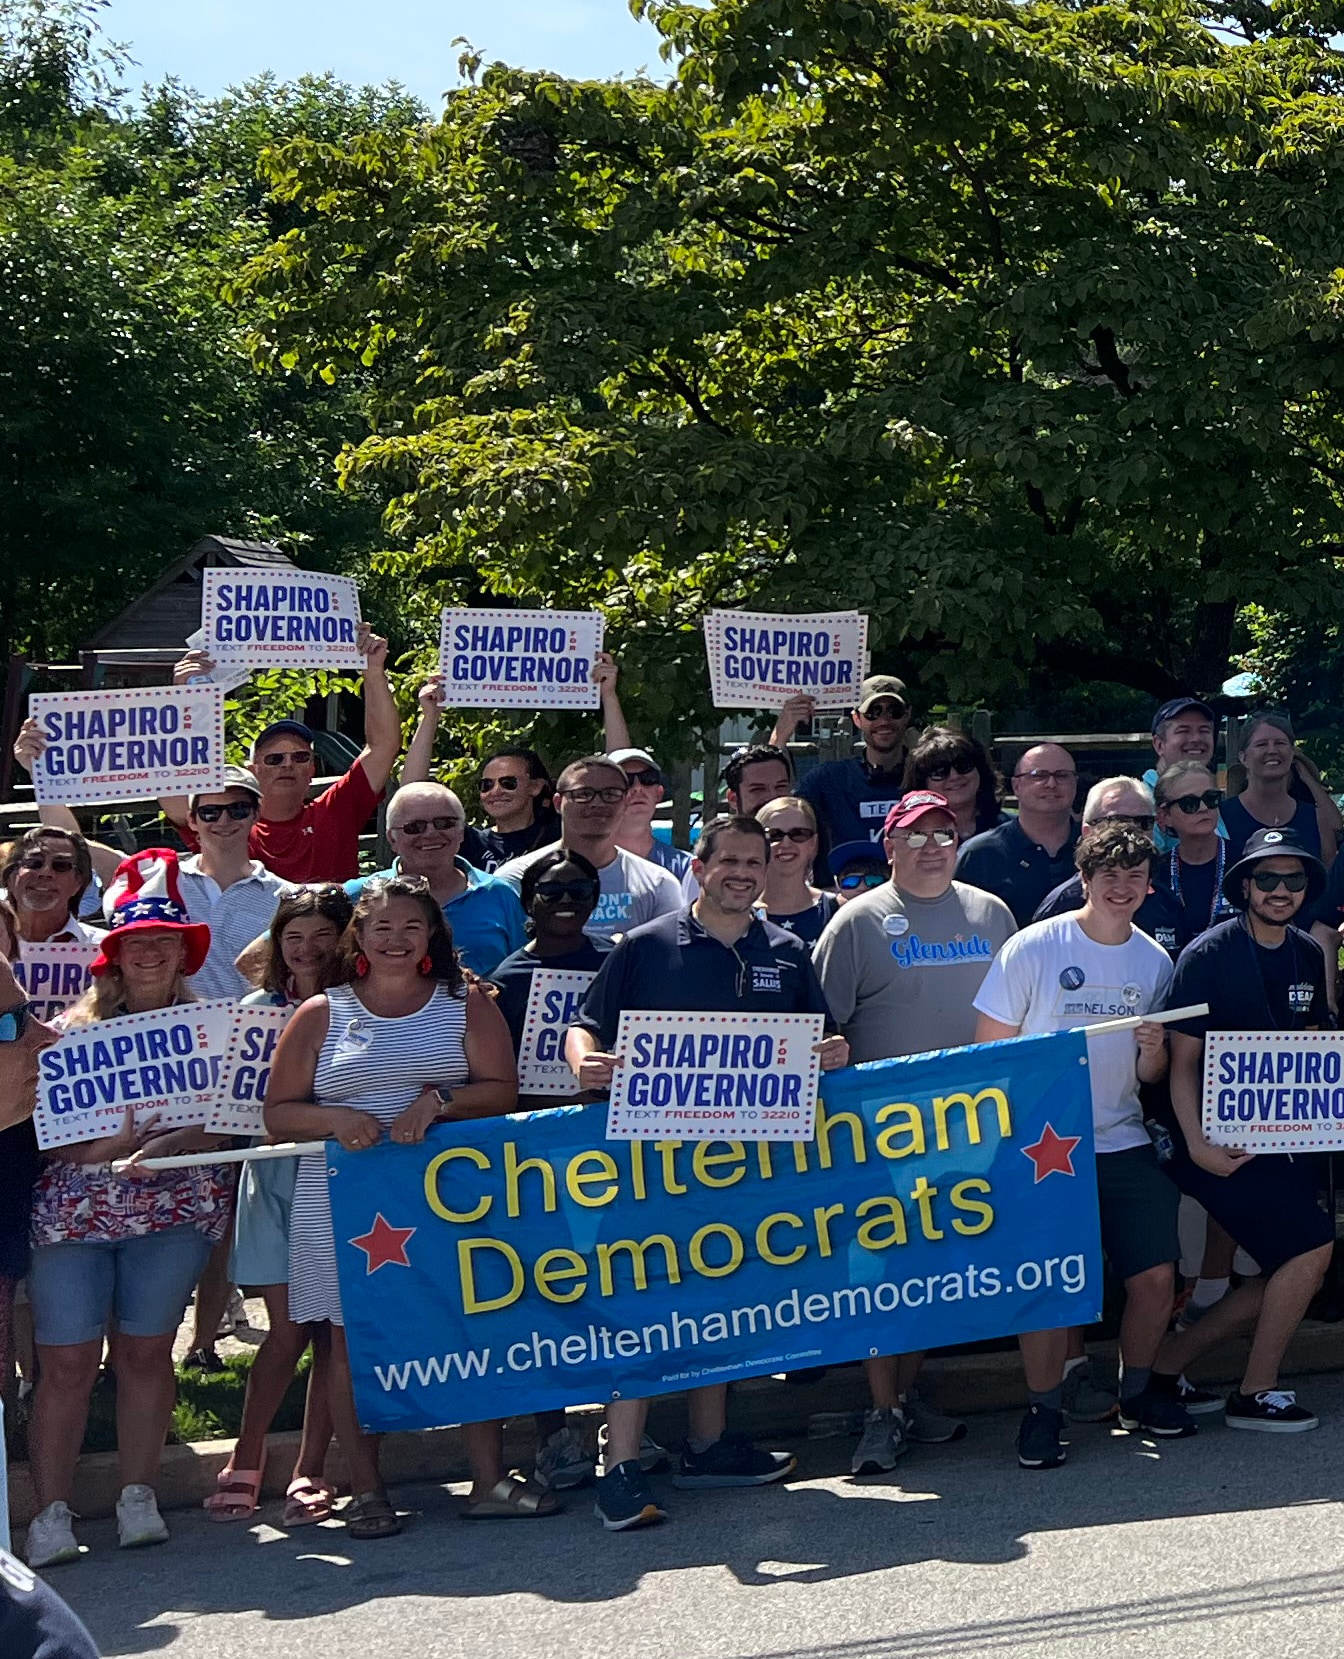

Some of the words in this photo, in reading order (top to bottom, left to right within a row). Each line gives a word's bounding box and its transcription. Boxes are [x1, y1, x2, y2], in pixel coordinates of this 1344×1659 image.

[217, 584, 329, 613] SHAPIRO
[215, 615, 354, 643] GOVERNOR
[454, 625, 565, 653] SHAPIRO
[724, 627, 829, 657] SHAPIRO
[452, 655, 588, 683] GOVERNOR
[725, 655, 852, 687] GOVERNOR
[44, 704, 178, 742] SHAPIRO
[46, 736, 210, 775] GOVERNOR
[46, 777, 78, 785] TEXT
[83, 772, 149, 783] FREEDOM
[154, 770, 170, 778] TO
[892, 935, 992, 968] Glenside
[1084, 1003, 1135, 1016] NELSON
[40, 1024, 193, 1081] SHAPIRO
[632, 1033, 773, 1068] SHAPIRO
[1219, 1051, 1340, 1084] SHAPIRO
[627, 1073, 801, 1107] GOVERNOR
[665, 1111, 735, 1119] FREEDOM
[740, 1111, 757, 1119] TO
[761, 1111, 800, 1119] 32210
[1251, 1124, 1312, 1132] FREEDOM
[457, 1177, 994, 1314] Democrats
[374, 1254, 1086, 1391] www.cheltenhamdemocrats.org
